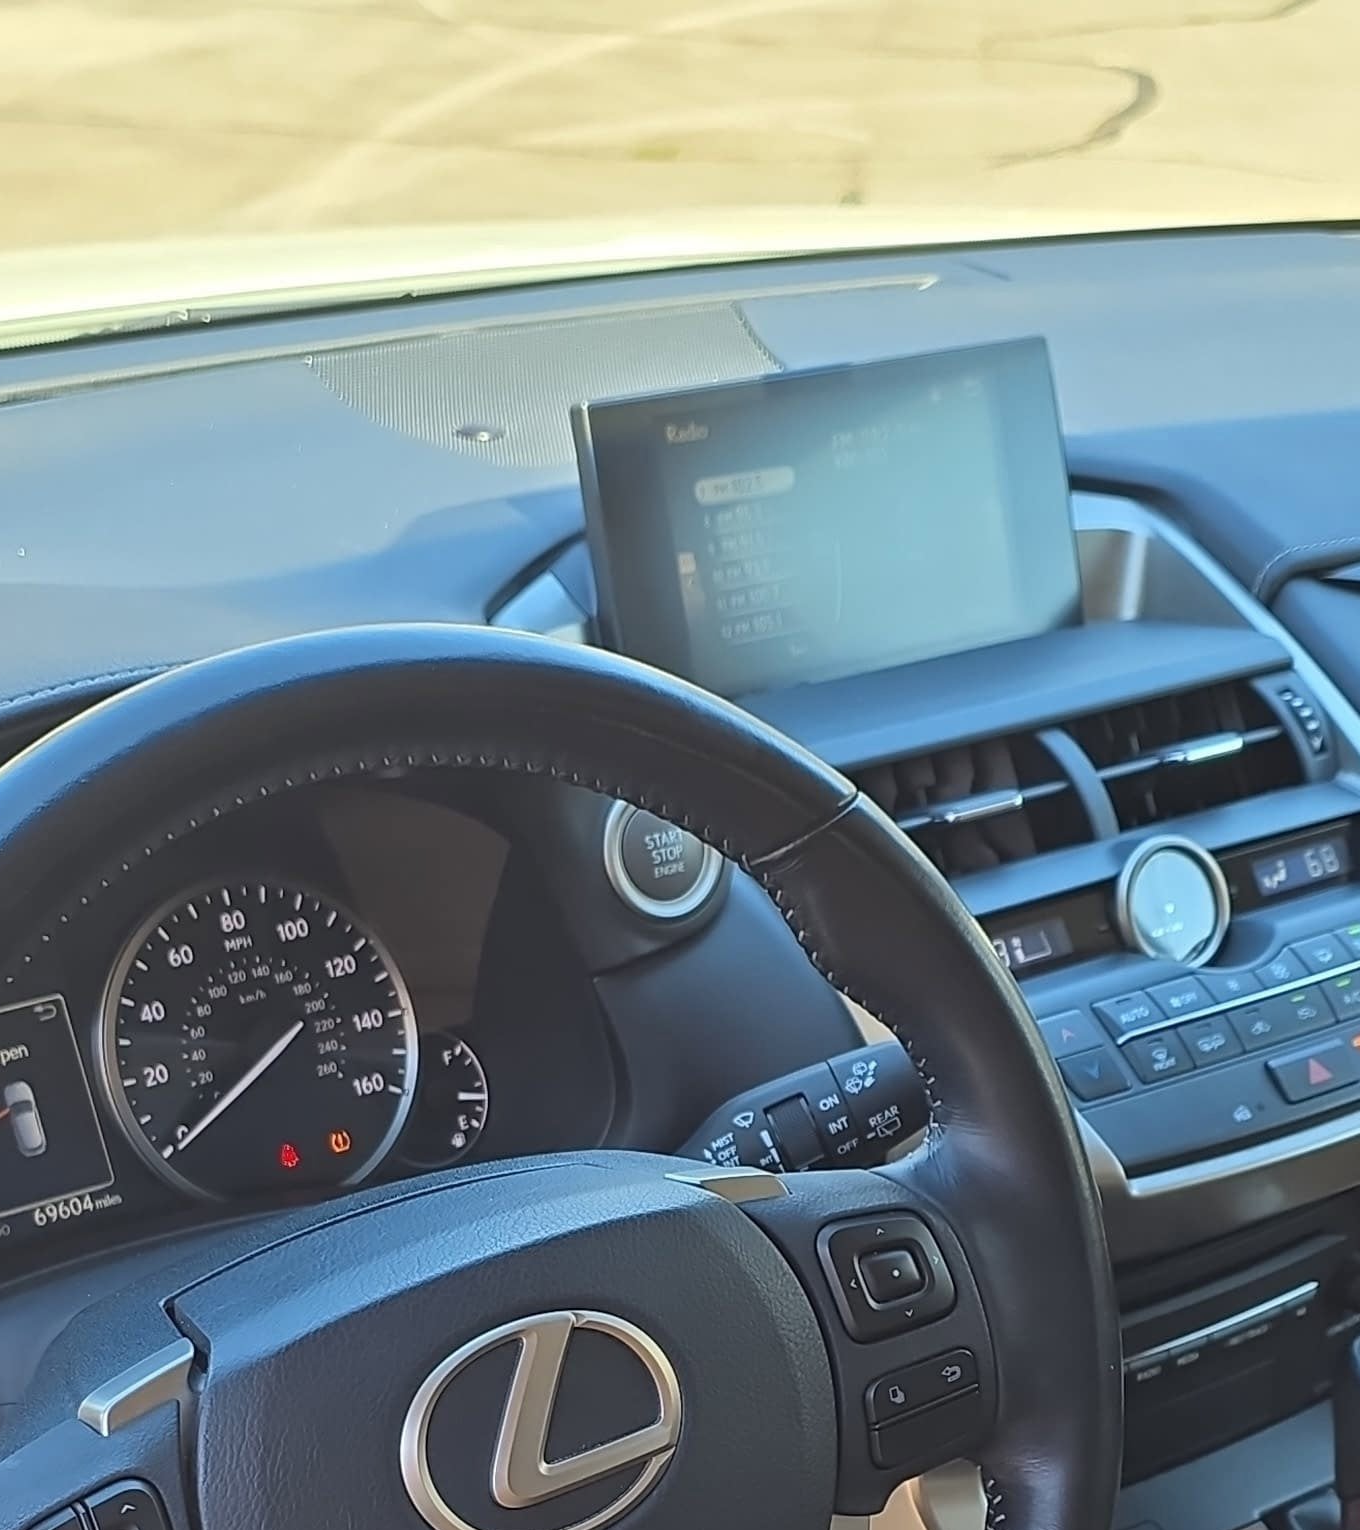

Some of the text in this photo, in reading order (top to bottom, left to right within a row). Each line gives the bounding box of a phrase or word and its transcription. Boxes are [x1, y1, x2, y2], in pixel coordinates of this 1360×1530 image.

[644, 829, 683, 850] START
[652, 844, 683, 865] STOP
[220, 909, 245, 932] 80
[276, 918, 309, 942] 100
[224, 935, 253, 952] MPH
[167, 945, 194, 967] 60
[251, 964, 271, 978] 140
[325, 954, 357, 978] 120
[228, 970, 247, 985] 120
[274, 970, 294, 984] 160
[208, 985, 228, 999] 100
[240, 989, 267, 1005] km/h
[292, 982, 312, 996] 180
[140, 1001, 165, 1023] 40
[196, 1003, 212, 1018] 80
[304, 999, 326, 1014] 200
[314, 1018, 335, 1034] 220
[352, 1008, 383, 1033] 140
[190, 1026, 206, 1040] 60
[192, 1049, 206, 1061] 40
[317, 1039, 339, 1054] 240
[443, 1049, 452, 1066] F
[143, 1063, 169, 1087] 20
[198, 1071, 213, 1084] 20
[316, 1061, 338, 1077] 260
[353, 1072, 385, 1096] 160
[819, 1093, 840, 1112] ON
[458, 1114, 469, 1131] E
[828, 1115, 850, 1135] INT
[868, 1105, 900, 1128] REAR
[711, 1132, 734, 1151] MIST
[837, 1137, 859, 1155] OFF
[717, 1146, 738, 1162] OFF
[33, 1193, 122, 1226] 69604 miles
